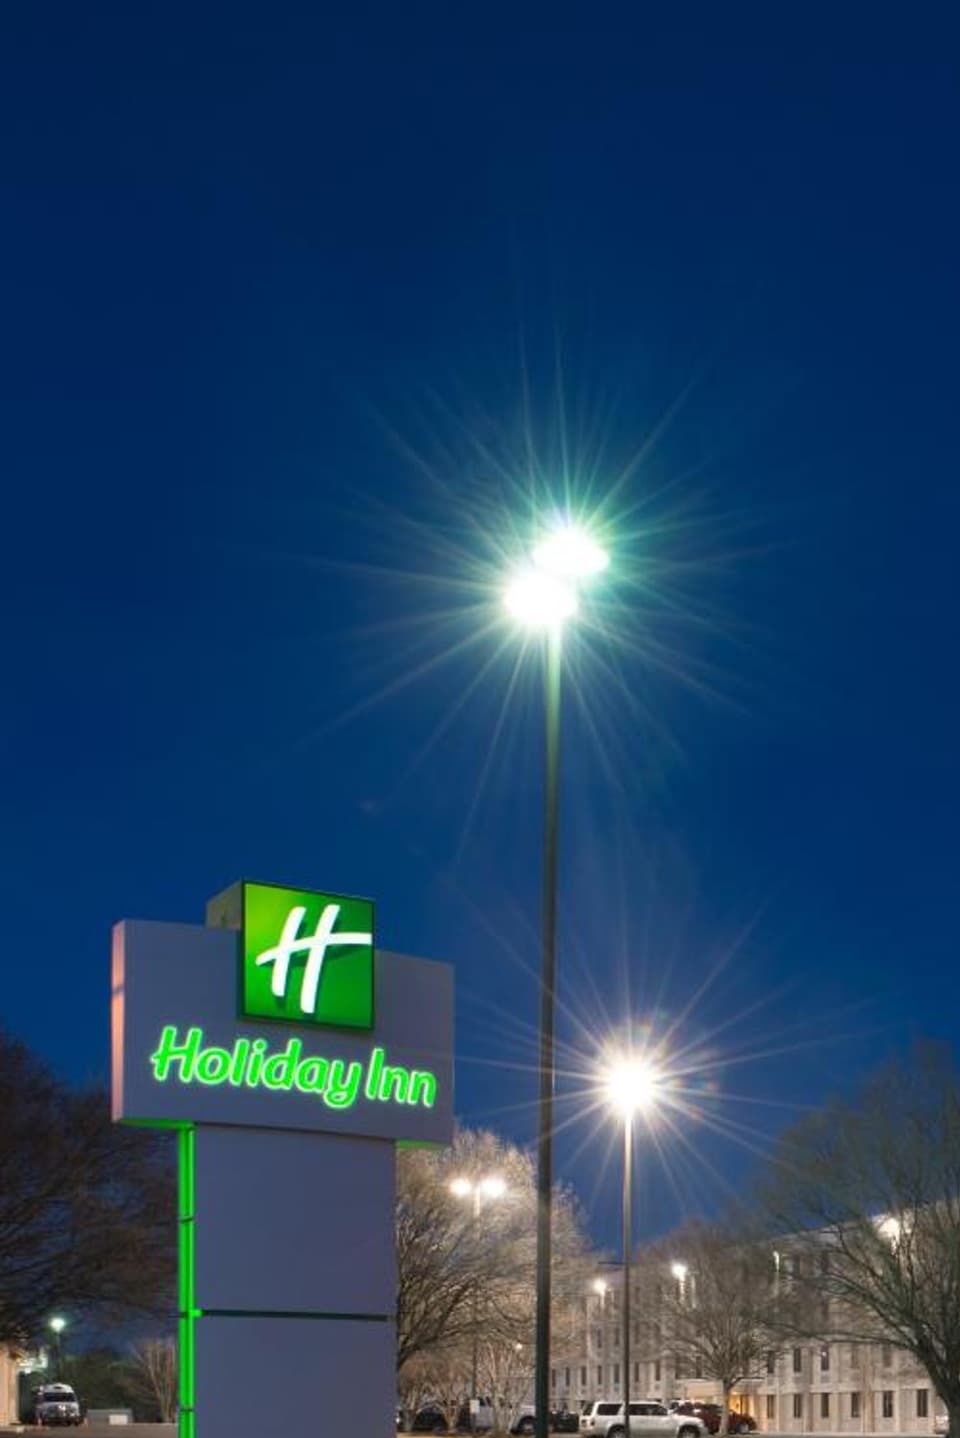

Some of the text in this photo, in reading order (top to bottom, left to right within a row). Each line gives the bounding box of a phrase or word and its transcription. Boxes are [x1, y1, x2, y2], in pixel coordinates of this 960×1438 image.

[256, 905, 372, 1013] H
[151, 1026, 437, 1107] Holiday Inn
